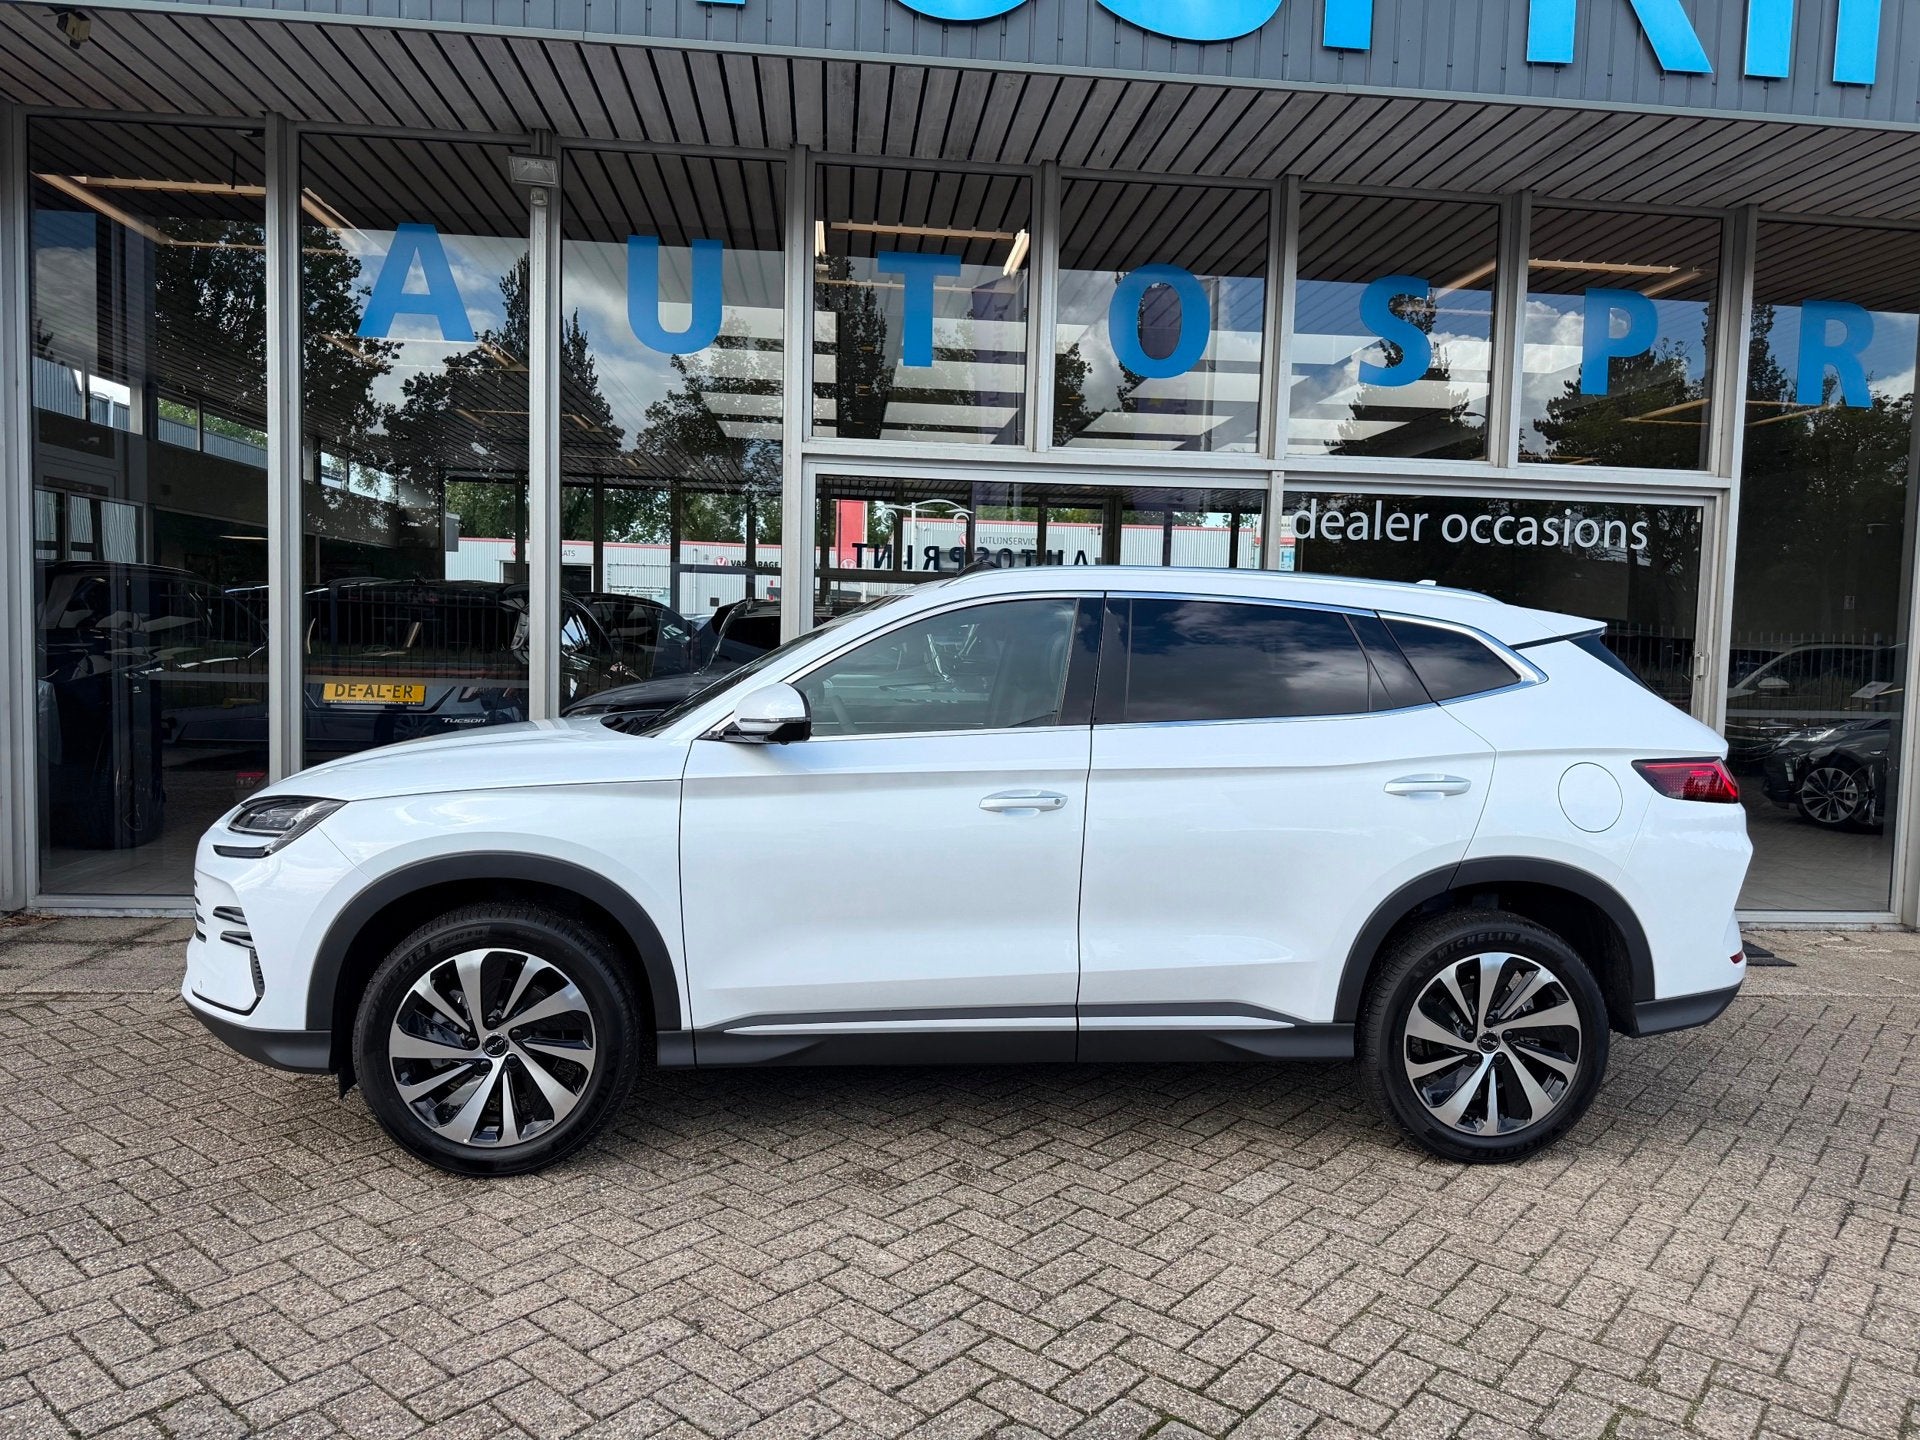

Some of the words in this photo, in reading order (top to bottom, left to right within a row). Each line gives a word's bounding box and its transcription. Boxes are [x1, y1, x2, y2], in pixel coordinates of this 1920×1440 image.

[1290, 498, 1428, 541] dealer
[1441, 508, 1649, 550] occasions
[980, 536, 1037, 546] UITLIJNSERVIC
[730, 559, 779, 569] VAKRAGE
[334, 683, 414, 699] DE-AL-ER
[1436, 932, 1517, 959] MICHELIN
